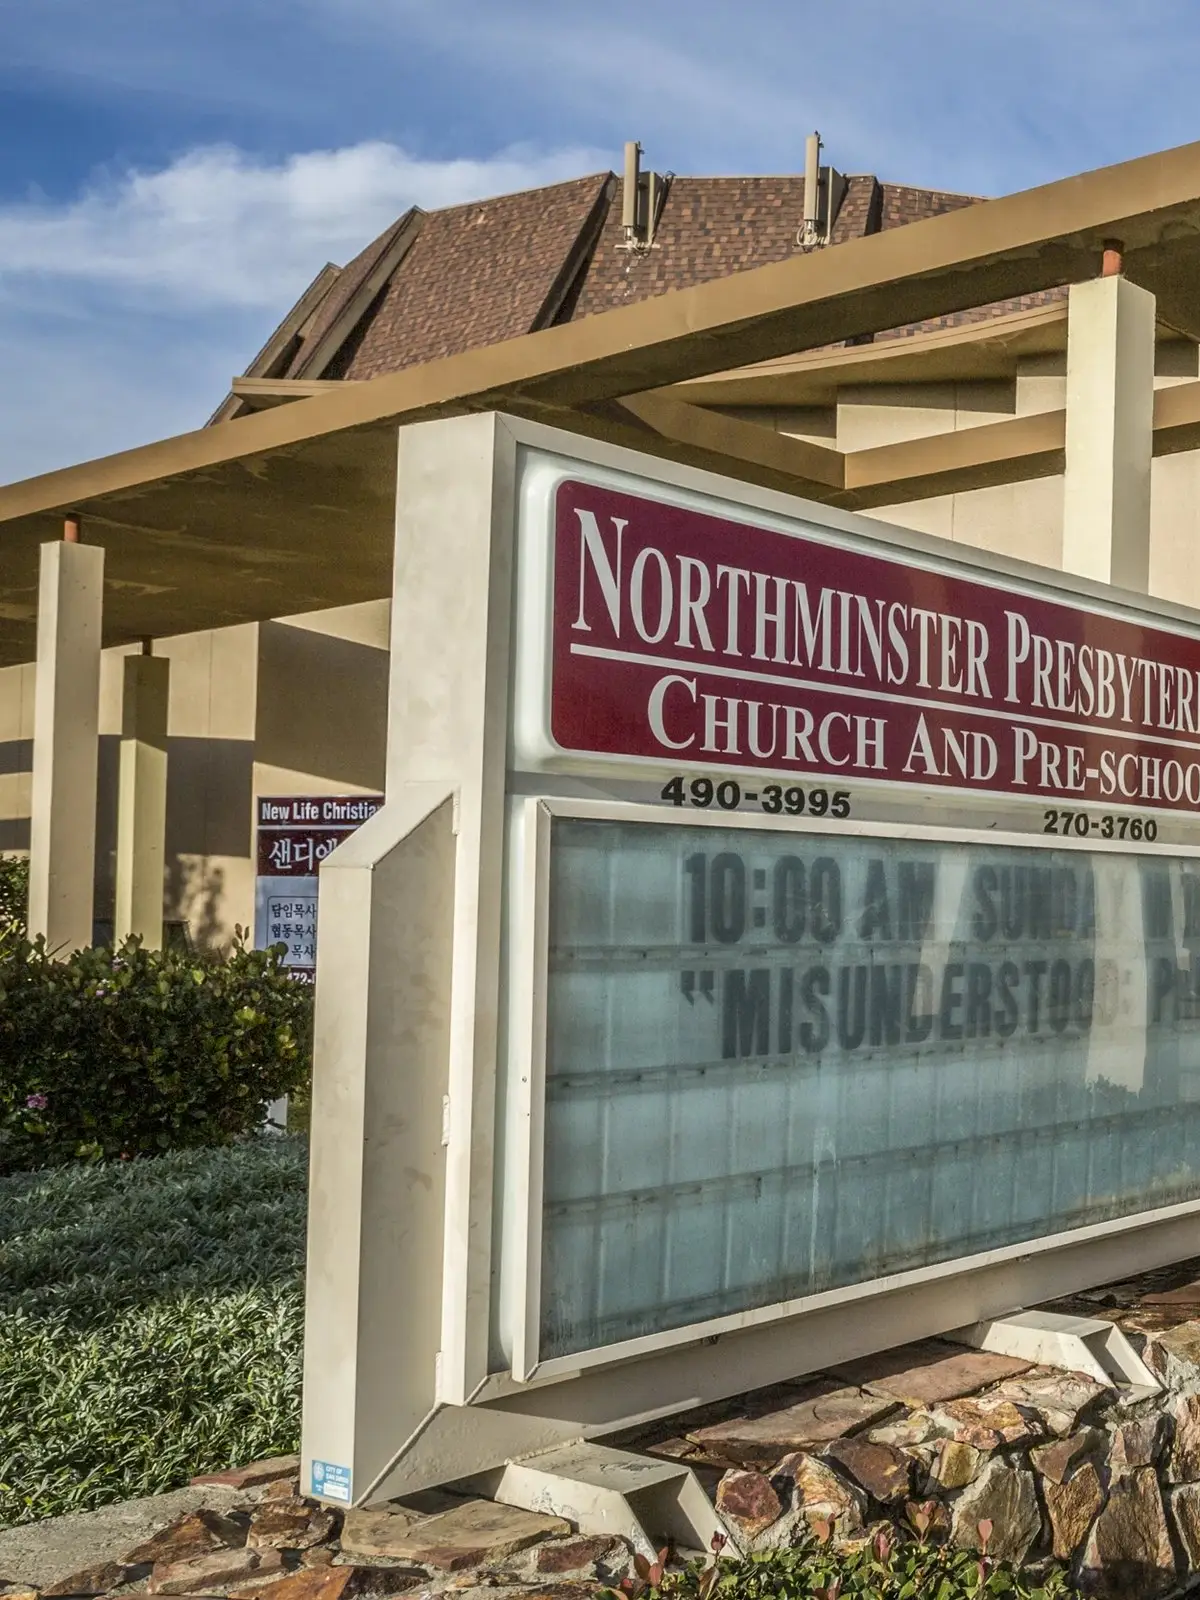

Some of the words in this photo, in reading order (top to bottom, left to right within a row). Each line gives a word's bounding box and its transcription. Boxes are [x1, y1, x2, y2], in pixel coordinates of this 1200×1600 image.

[262, 802, 290, 820] New
[293, 802, 319, 820] Life
[323, 801, 379, 820] Christia
[660, 776, 852, 819] 490-3995
[1043, 809, 1158, 842] 270-3760
[684, 851, 841, 944] 10:00
